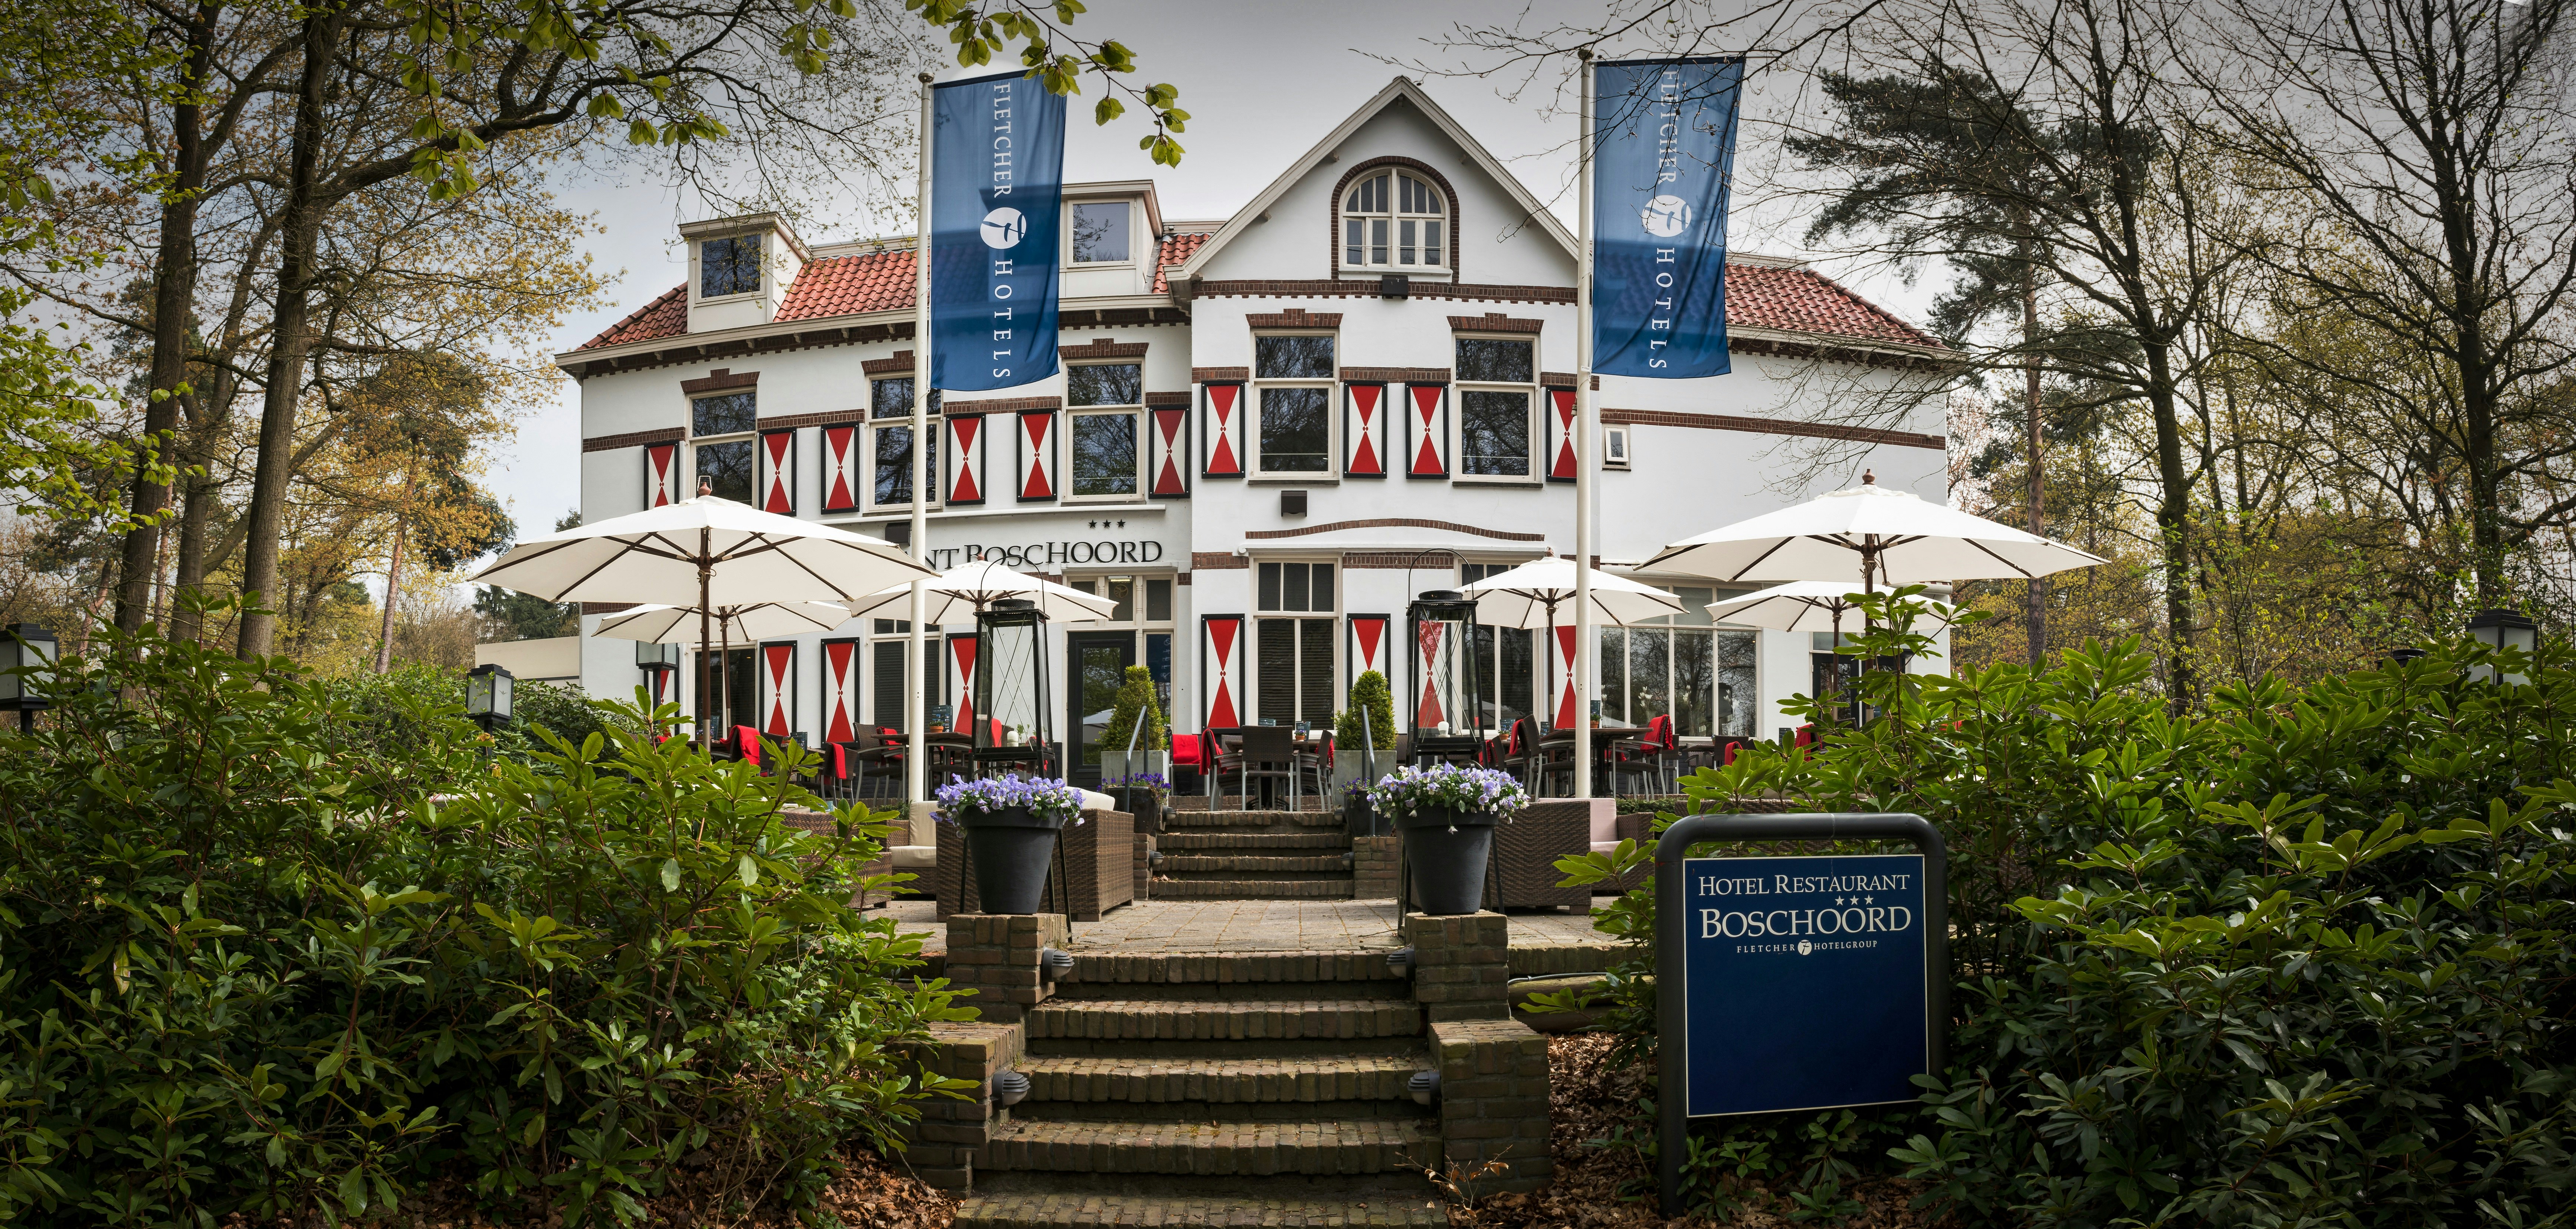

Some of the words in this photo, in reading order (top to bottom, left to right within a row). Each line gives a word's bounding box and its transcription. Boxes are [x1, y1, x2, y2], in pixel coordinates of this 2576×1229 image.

[994, 82, 1012, 199] FLETCHER
[1658, 70, 1679, 185] FLETCHER
[993, 259, 1012, 378] HOTELS
[1649, 248, 1675, 369] HOTELS
[964, 541, 1163, 567] BOSCHOORD
[1699, 876, 1769, 896] HOTEL
[1774, 874, 1910, 894] RESTAURANT
[1699, 907, 1911, 938] BOSCHOORD
[1737, 944, 1795, 953] FLETCHER
[1814, 940, 1878, 950] HOTELGROUP
